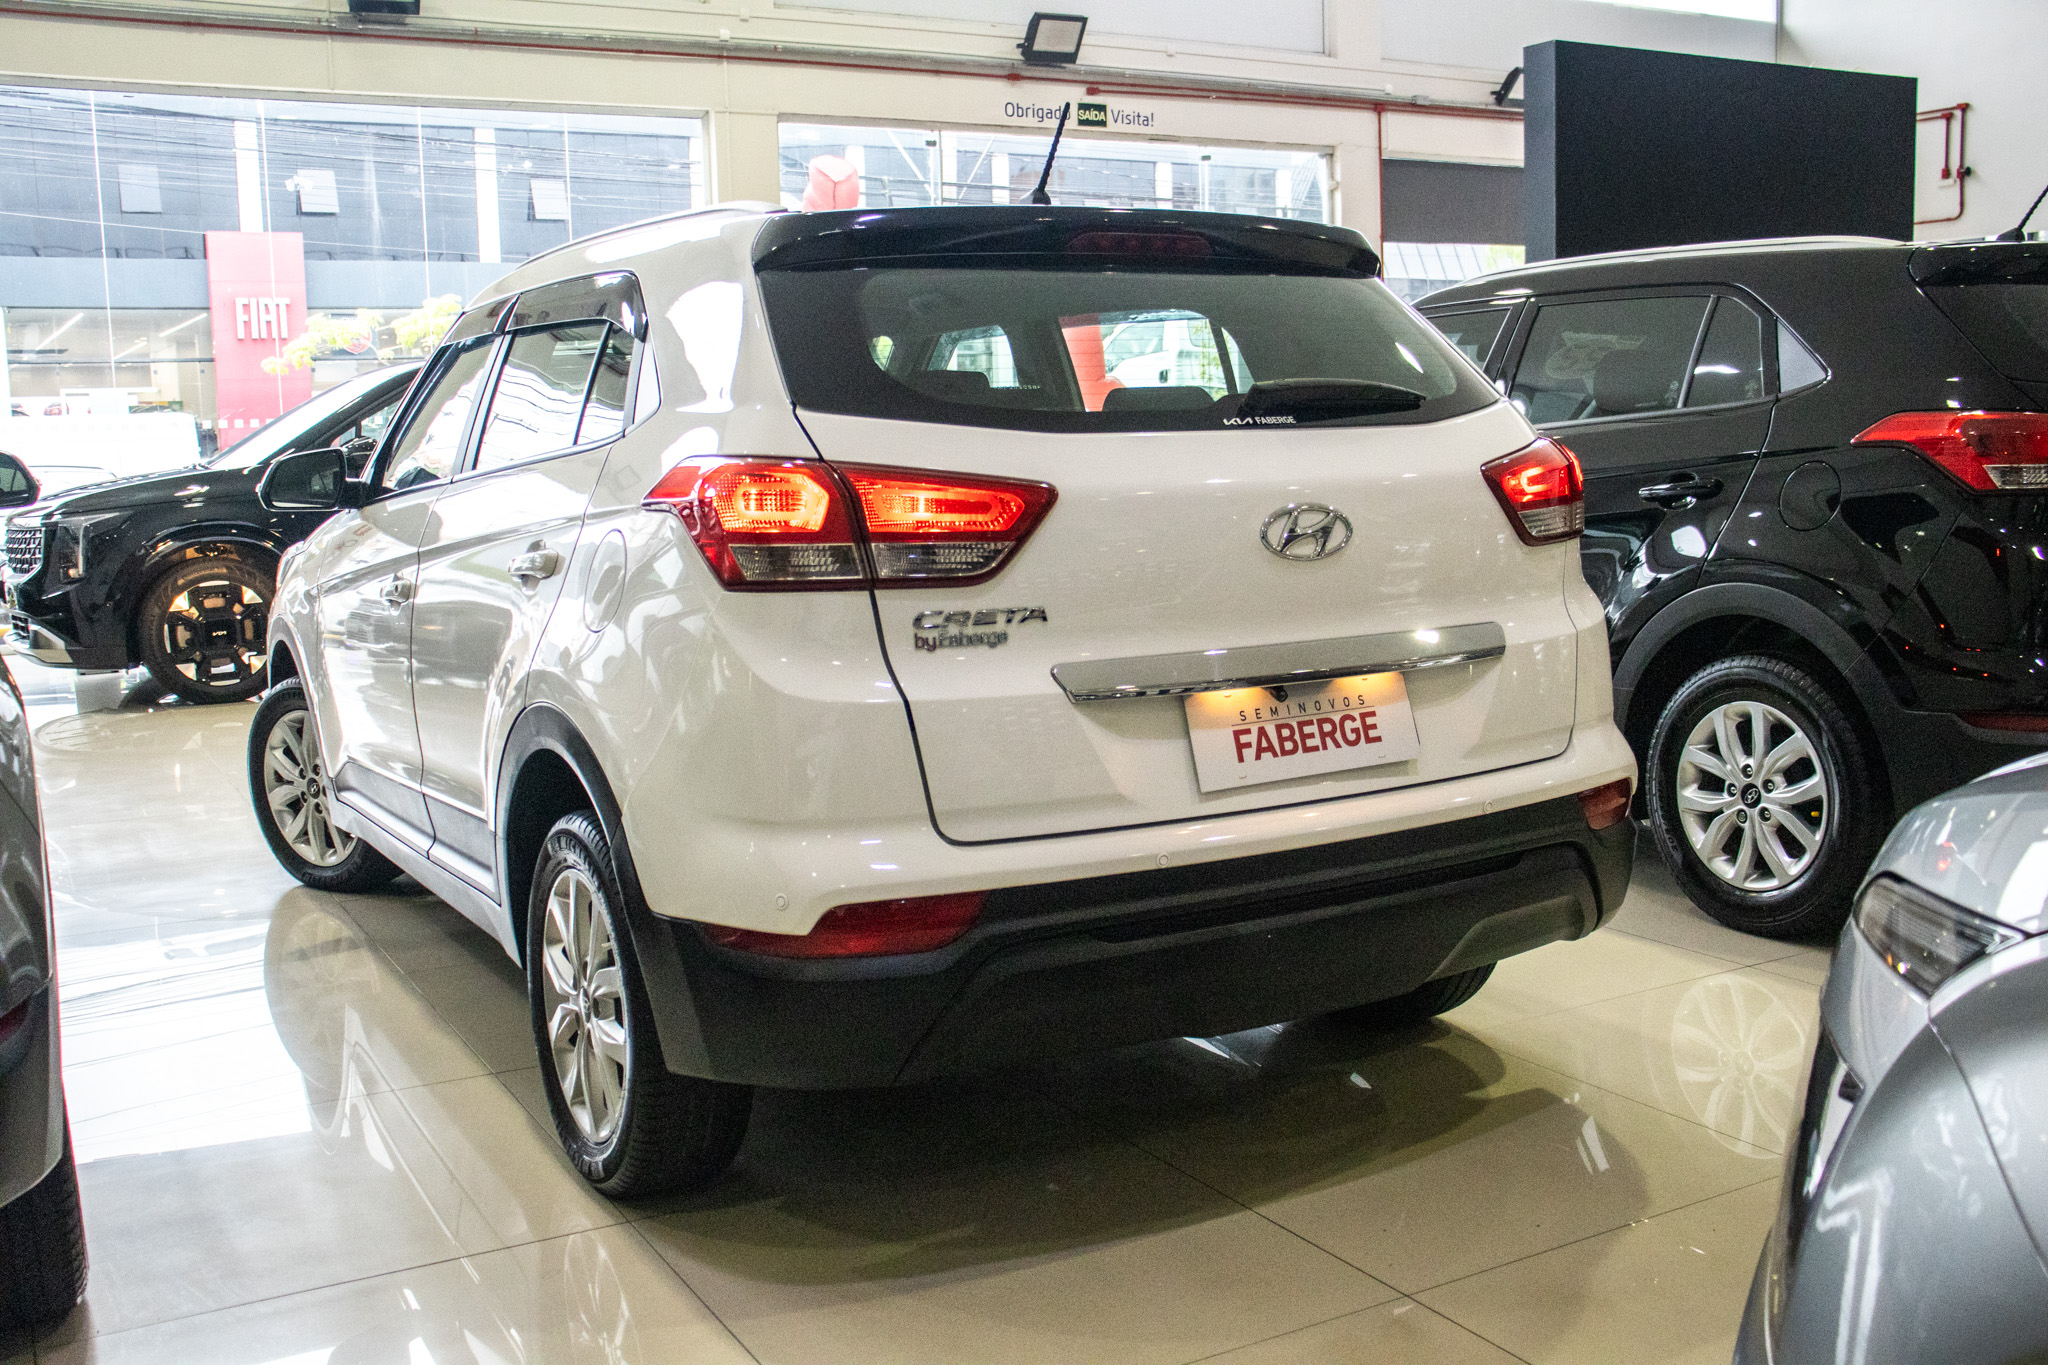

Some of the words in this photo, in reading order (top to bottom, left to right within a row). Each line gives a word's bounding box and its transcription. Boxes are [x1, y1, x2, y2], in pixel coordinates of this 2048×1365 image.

[1078, 108, 1107, 122] SAÍDA
[1110, 109, 1155, 127] Visita!
[235, 297, 291, 341] FIAT
[1254, 416, 1297, 425] FABERGE
[913, 607, 1048, 629] CRETA
[1239, 694, 1366, 722] SEMINOVOS
[1232, 710, 1383, 764] FABERGE
